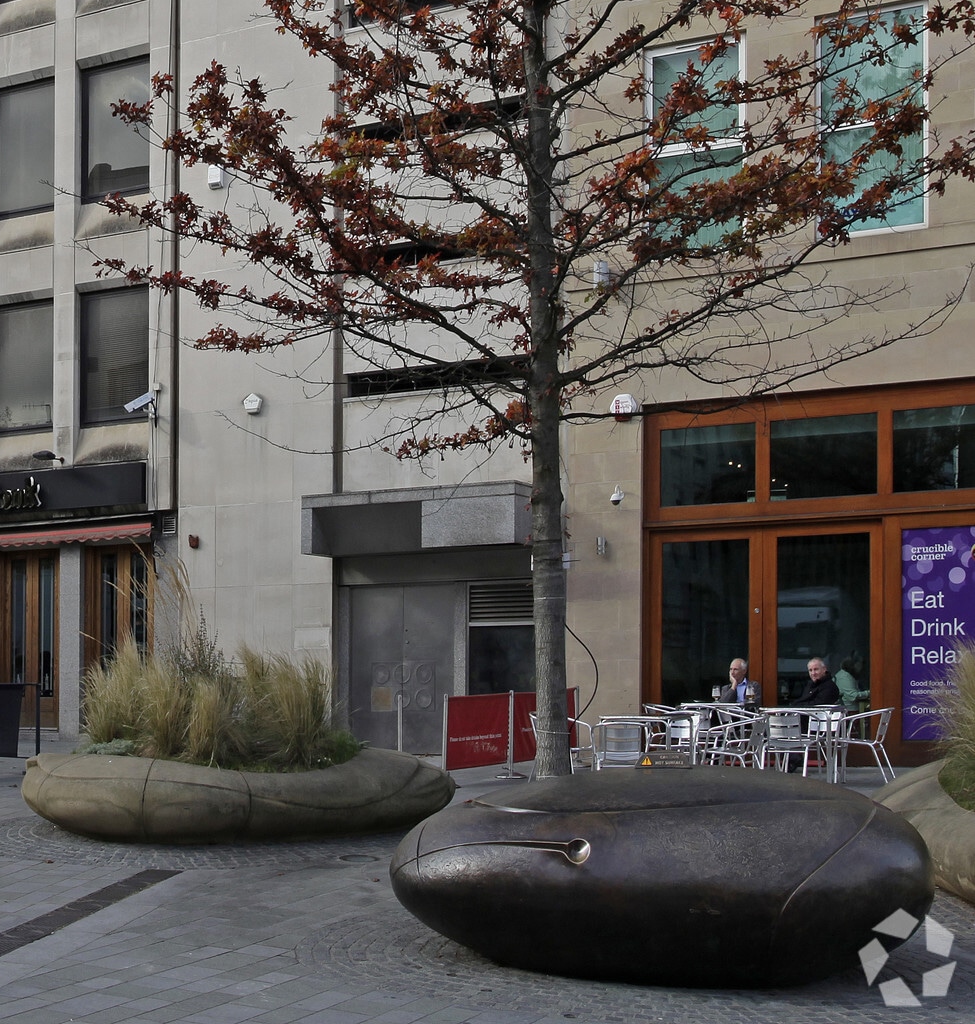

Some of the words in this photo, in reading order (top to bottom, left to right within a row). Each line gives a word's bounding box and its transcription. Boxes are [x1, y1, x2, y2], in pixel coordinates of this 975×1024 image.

[910, 543, 954, 554] crucible
[910, 553, 946, 562] corner
[911, 590, 945, 609] Eat
[911, 617, 966, 637] Drink
[910, 705, 937, 714] Come
